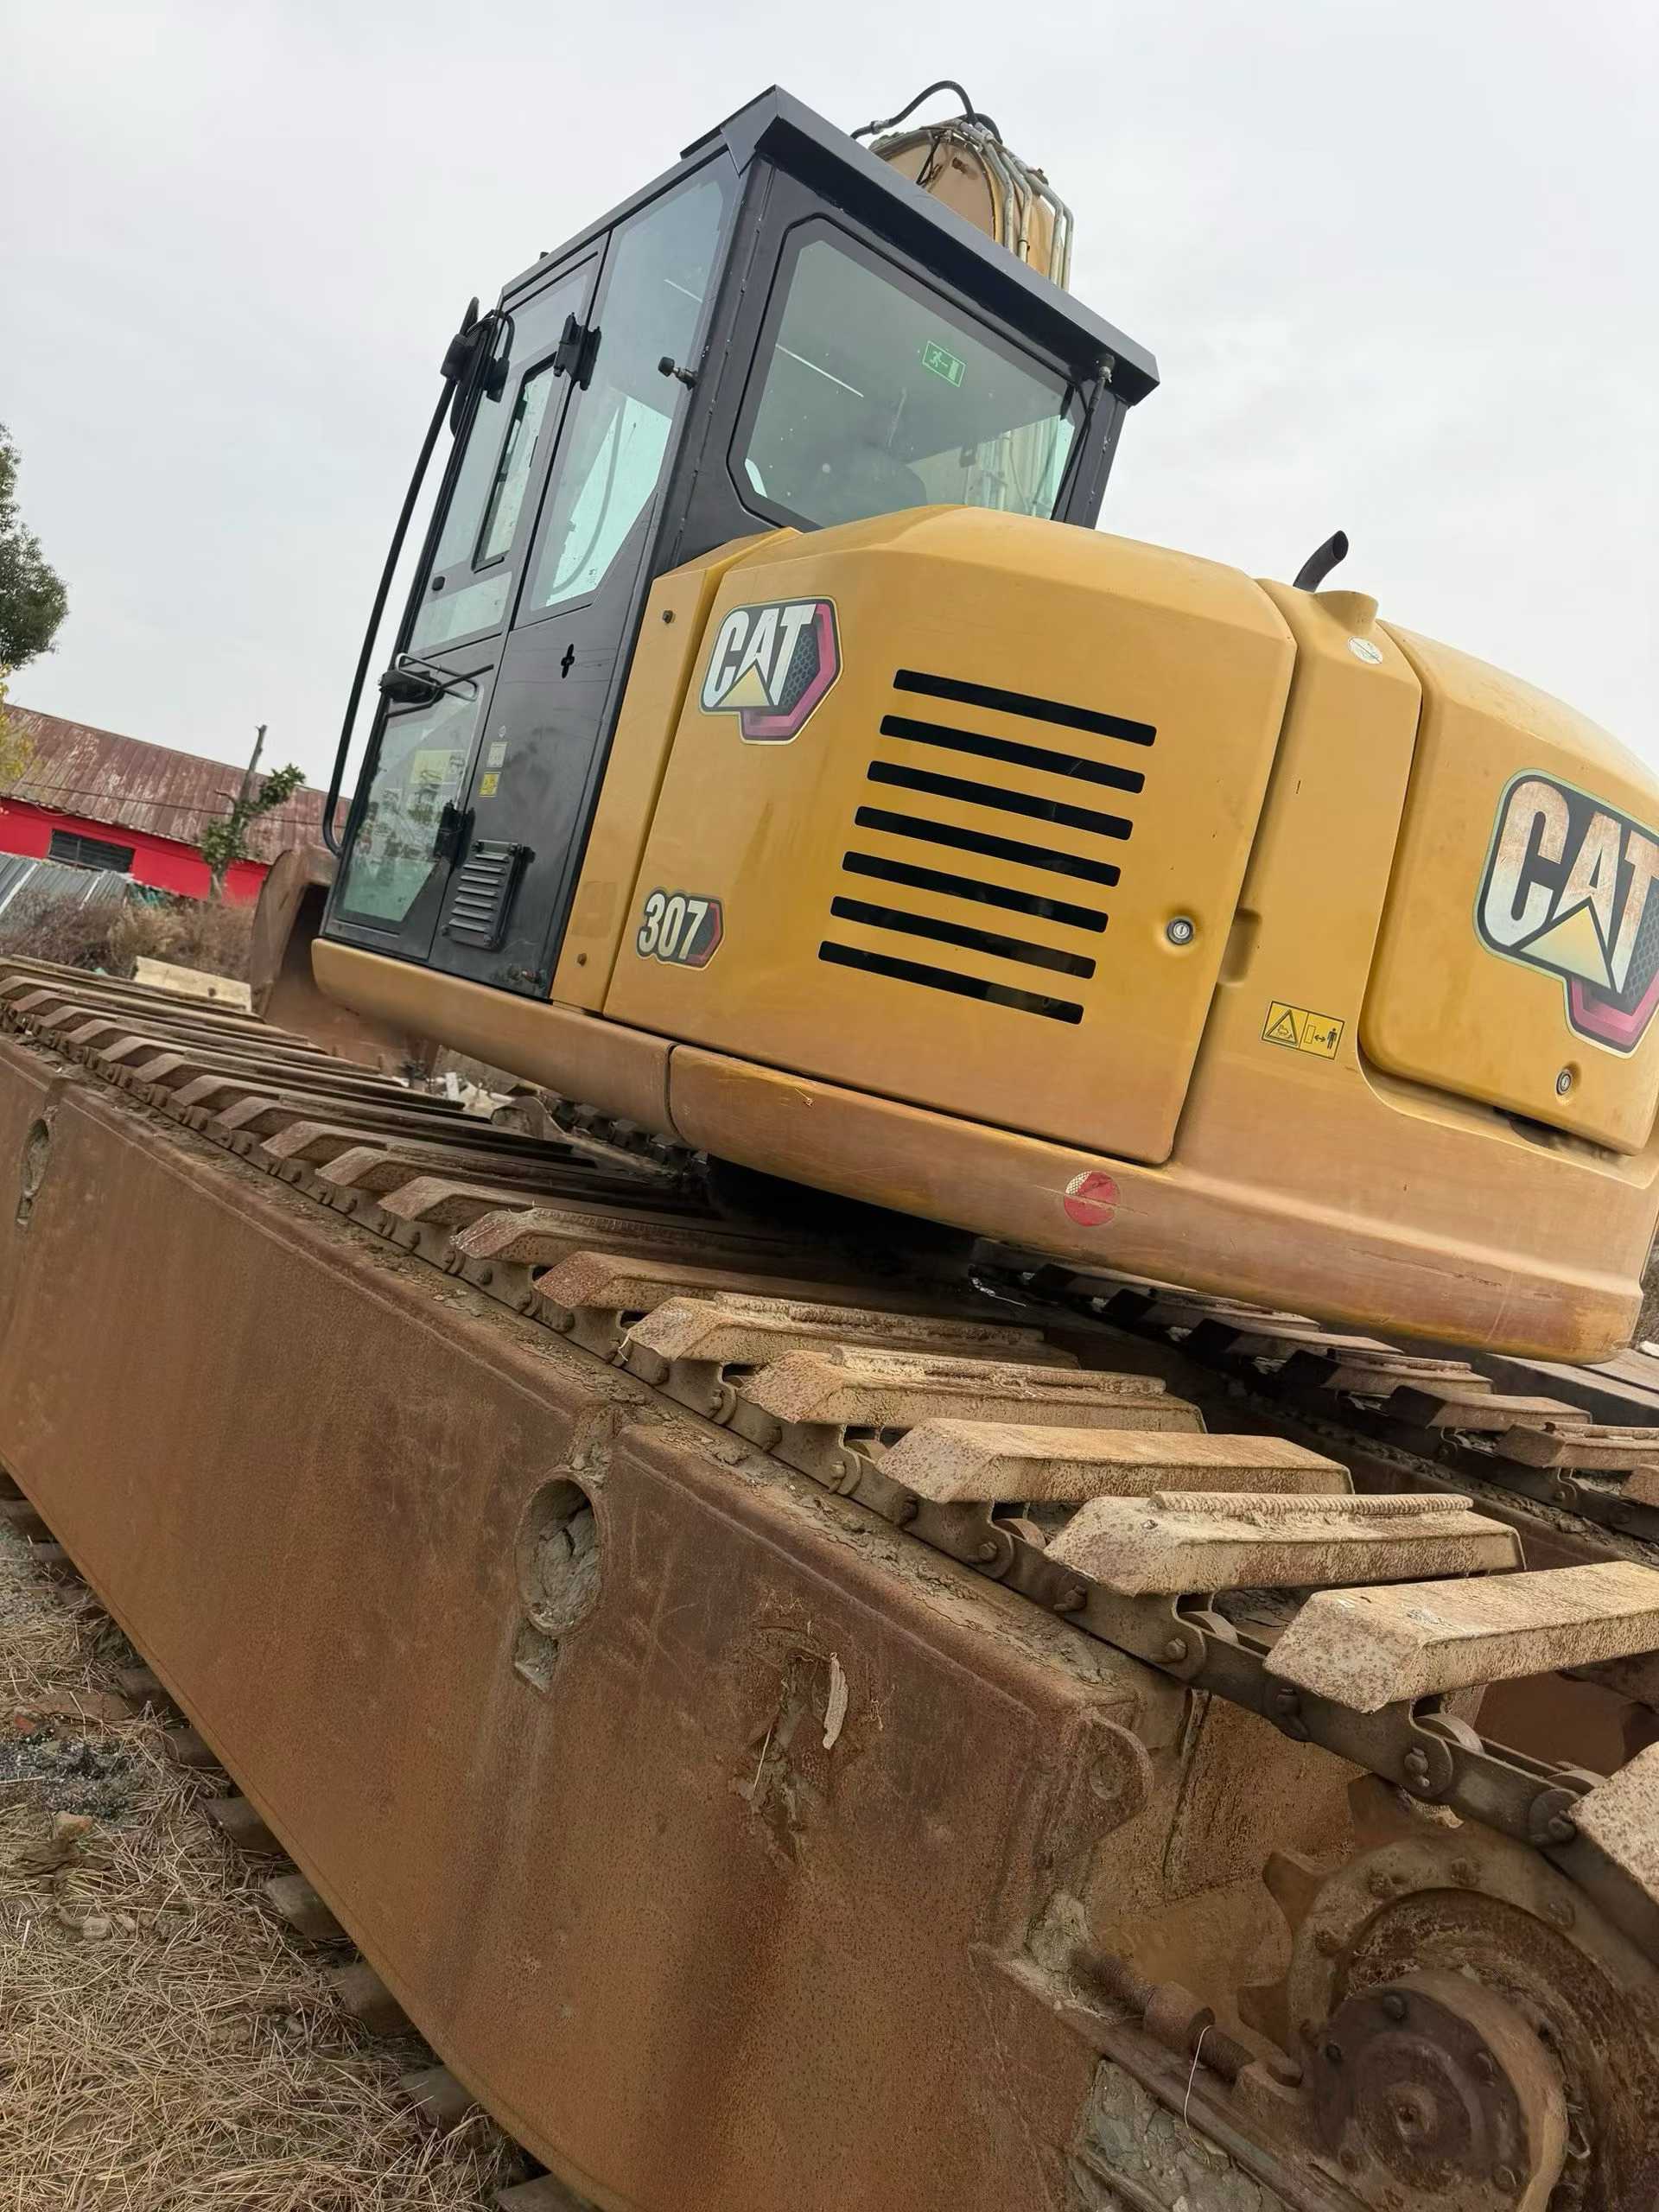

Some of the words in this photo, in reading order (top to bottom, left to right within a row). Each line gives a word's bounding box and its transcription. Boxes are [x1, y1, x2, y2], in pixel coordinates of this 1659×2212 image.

[703, 604, 817, 707] CAT
[639, 893, 709, 959] 307
[1484, 781, 1659, 994] CAT
